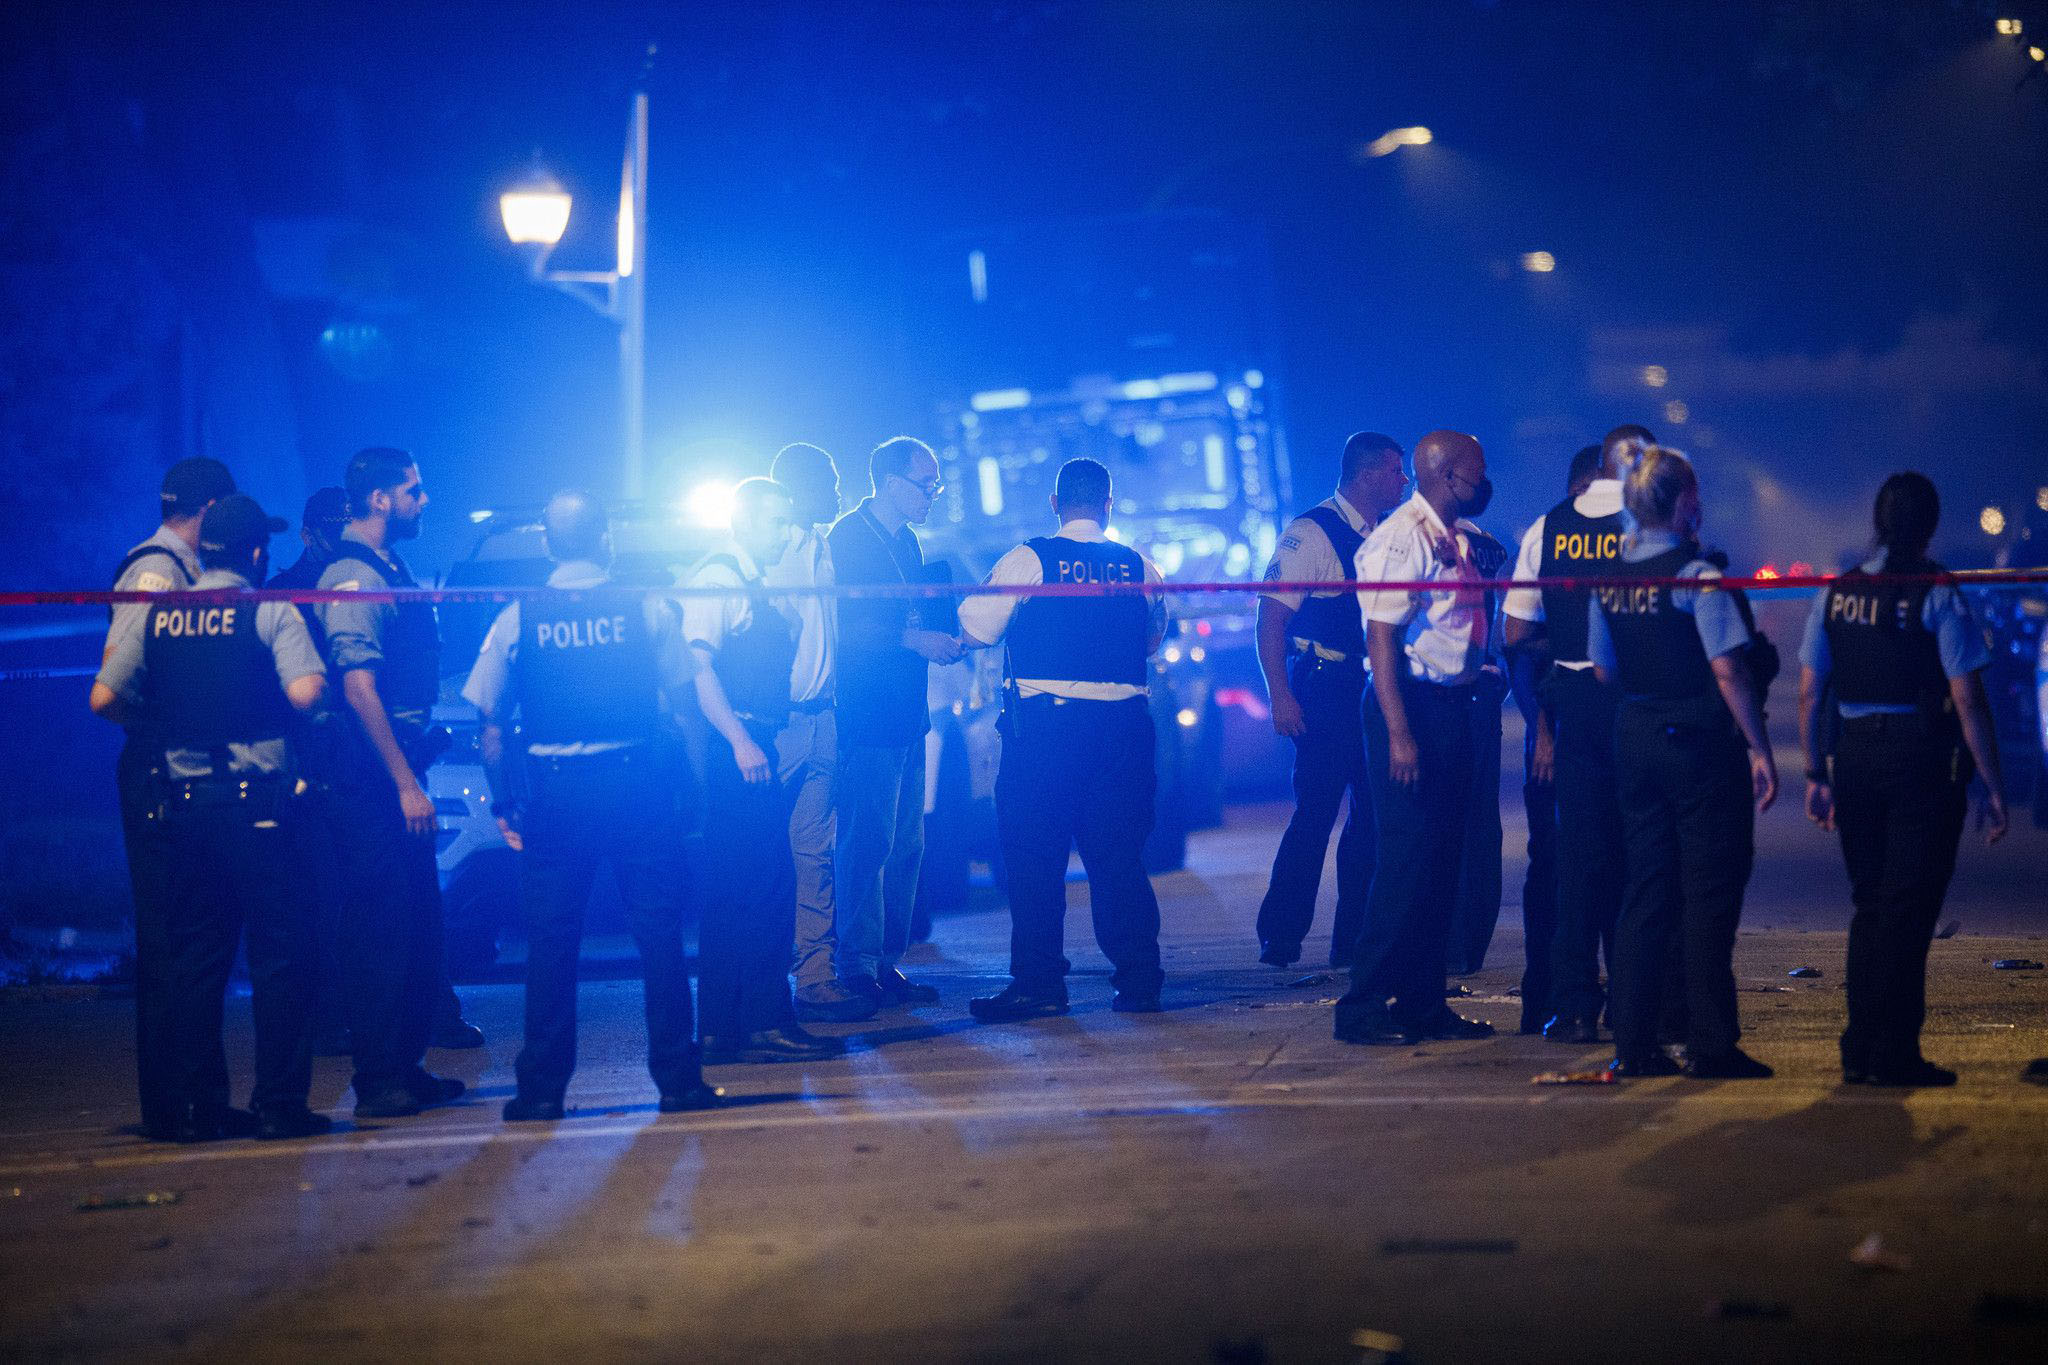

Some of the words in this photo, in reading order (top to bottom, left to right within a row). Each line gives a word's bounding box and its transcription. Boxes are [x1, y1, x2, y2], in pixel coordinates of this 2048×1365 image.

[1058, 560, 1131, 586] POLICE
[154, 608, 236, 638] POLICE
[1830, 593, 1909, 630] POLIE
[537, 616, 625, 648] POLICE
